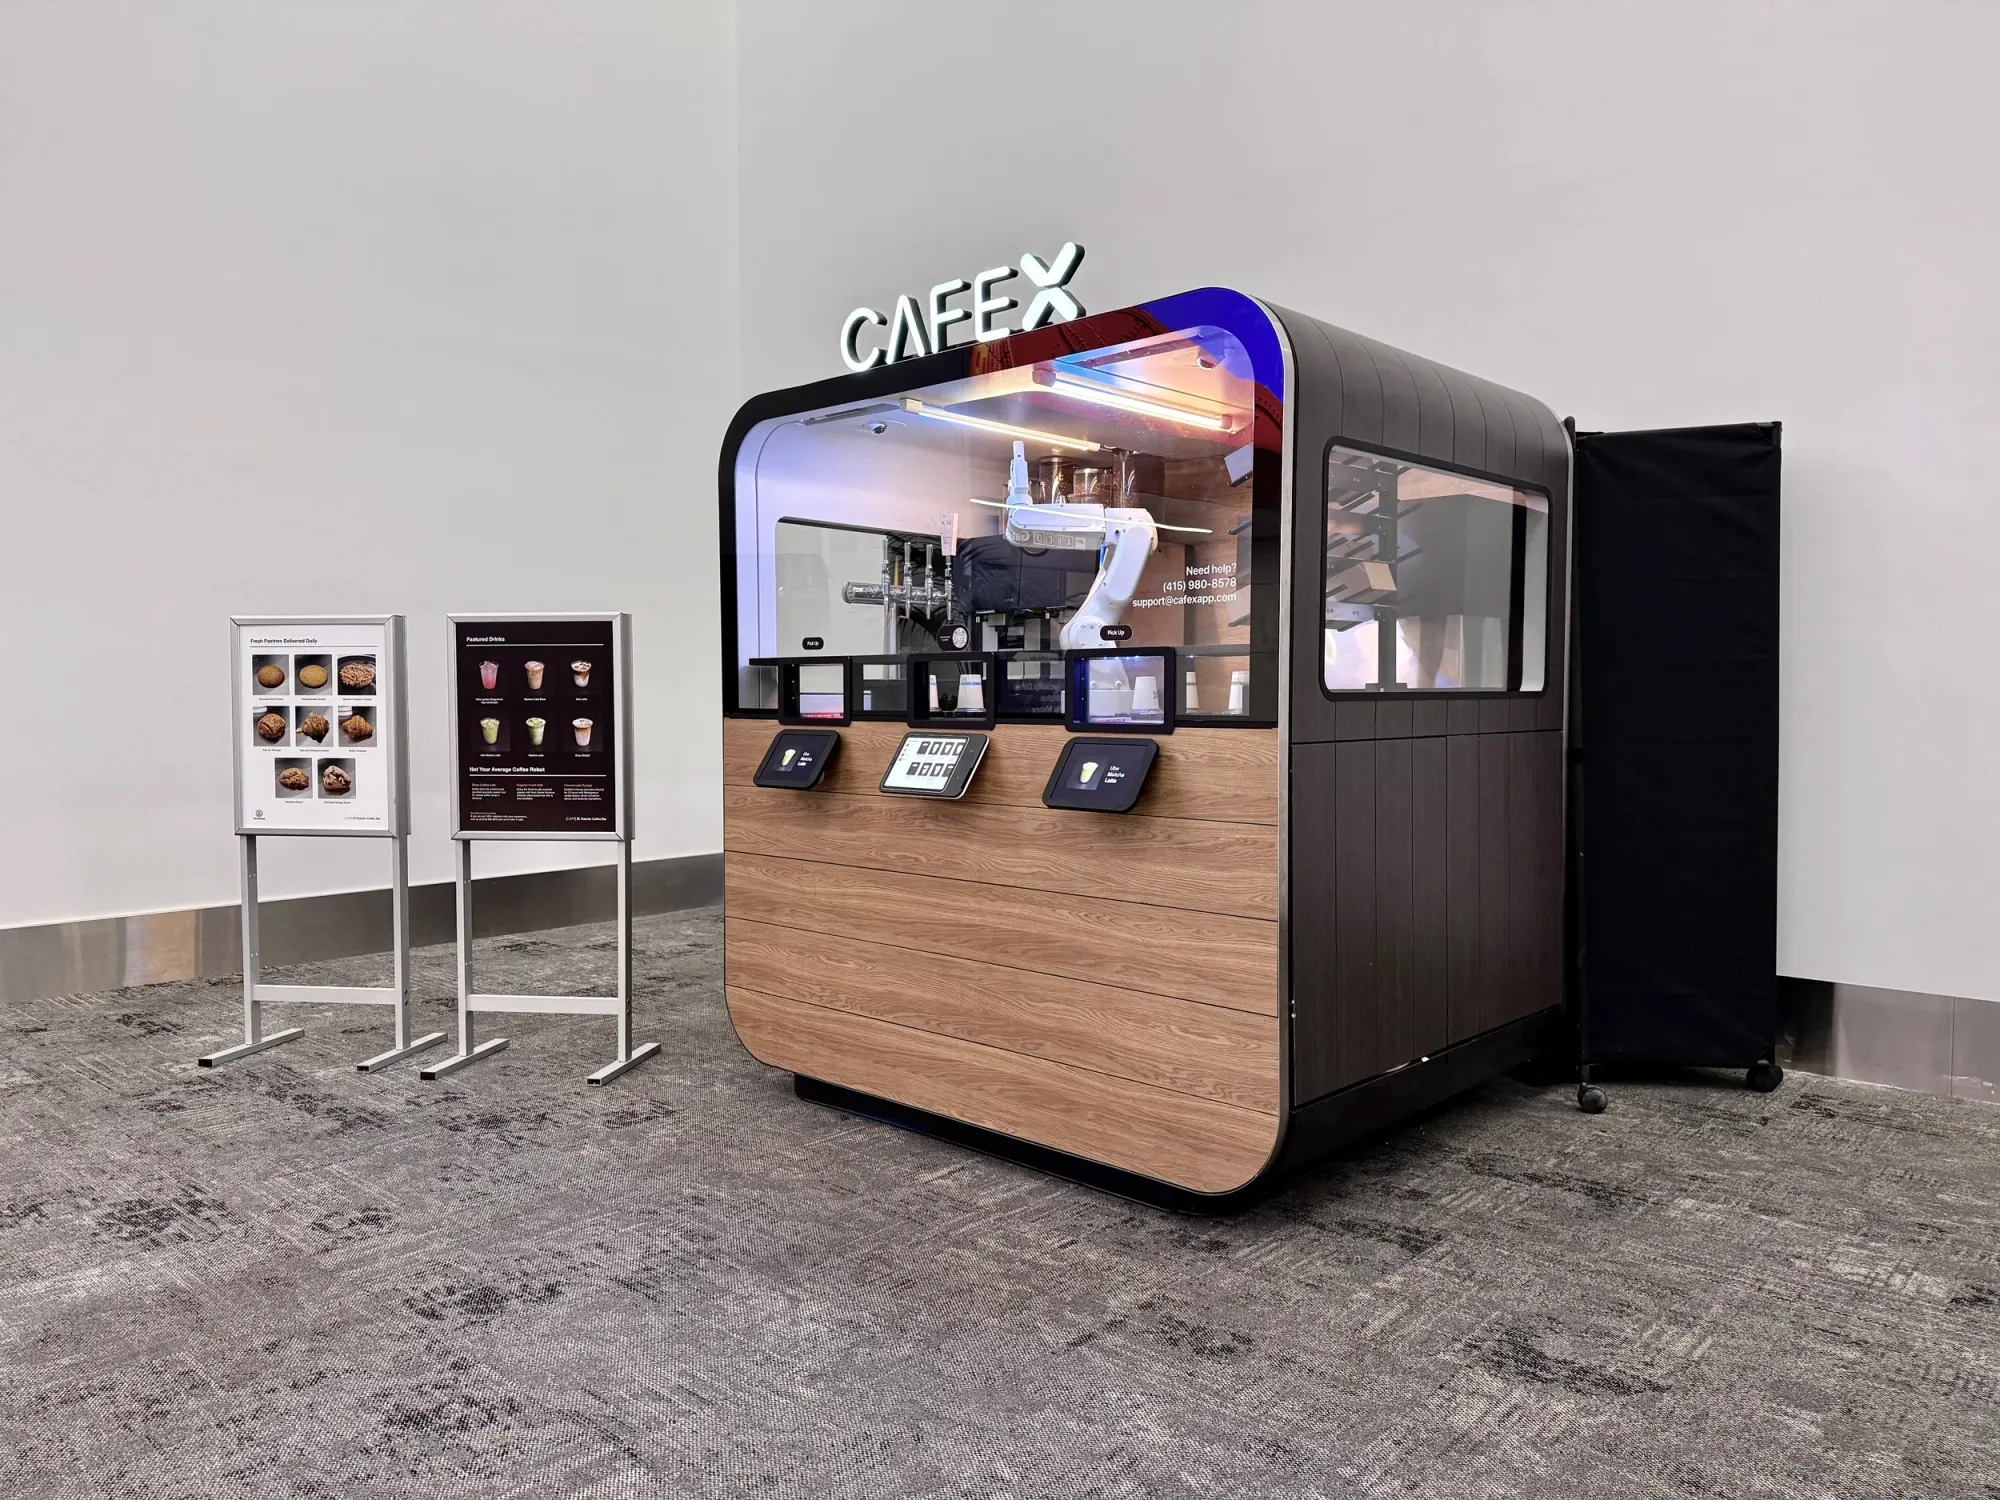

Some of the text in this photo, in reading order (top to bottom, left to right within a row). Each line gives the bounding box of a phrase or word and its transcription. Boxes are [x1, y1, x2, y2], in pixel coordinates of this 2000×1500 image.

[1186, 563, 1237, 577] Need help?
[1163, 577, 1237, 593] (415) 980-8578
[1132, 592, 1237, 609] support@cafexapp.com
[1117, 629, 1125, 637] Up
